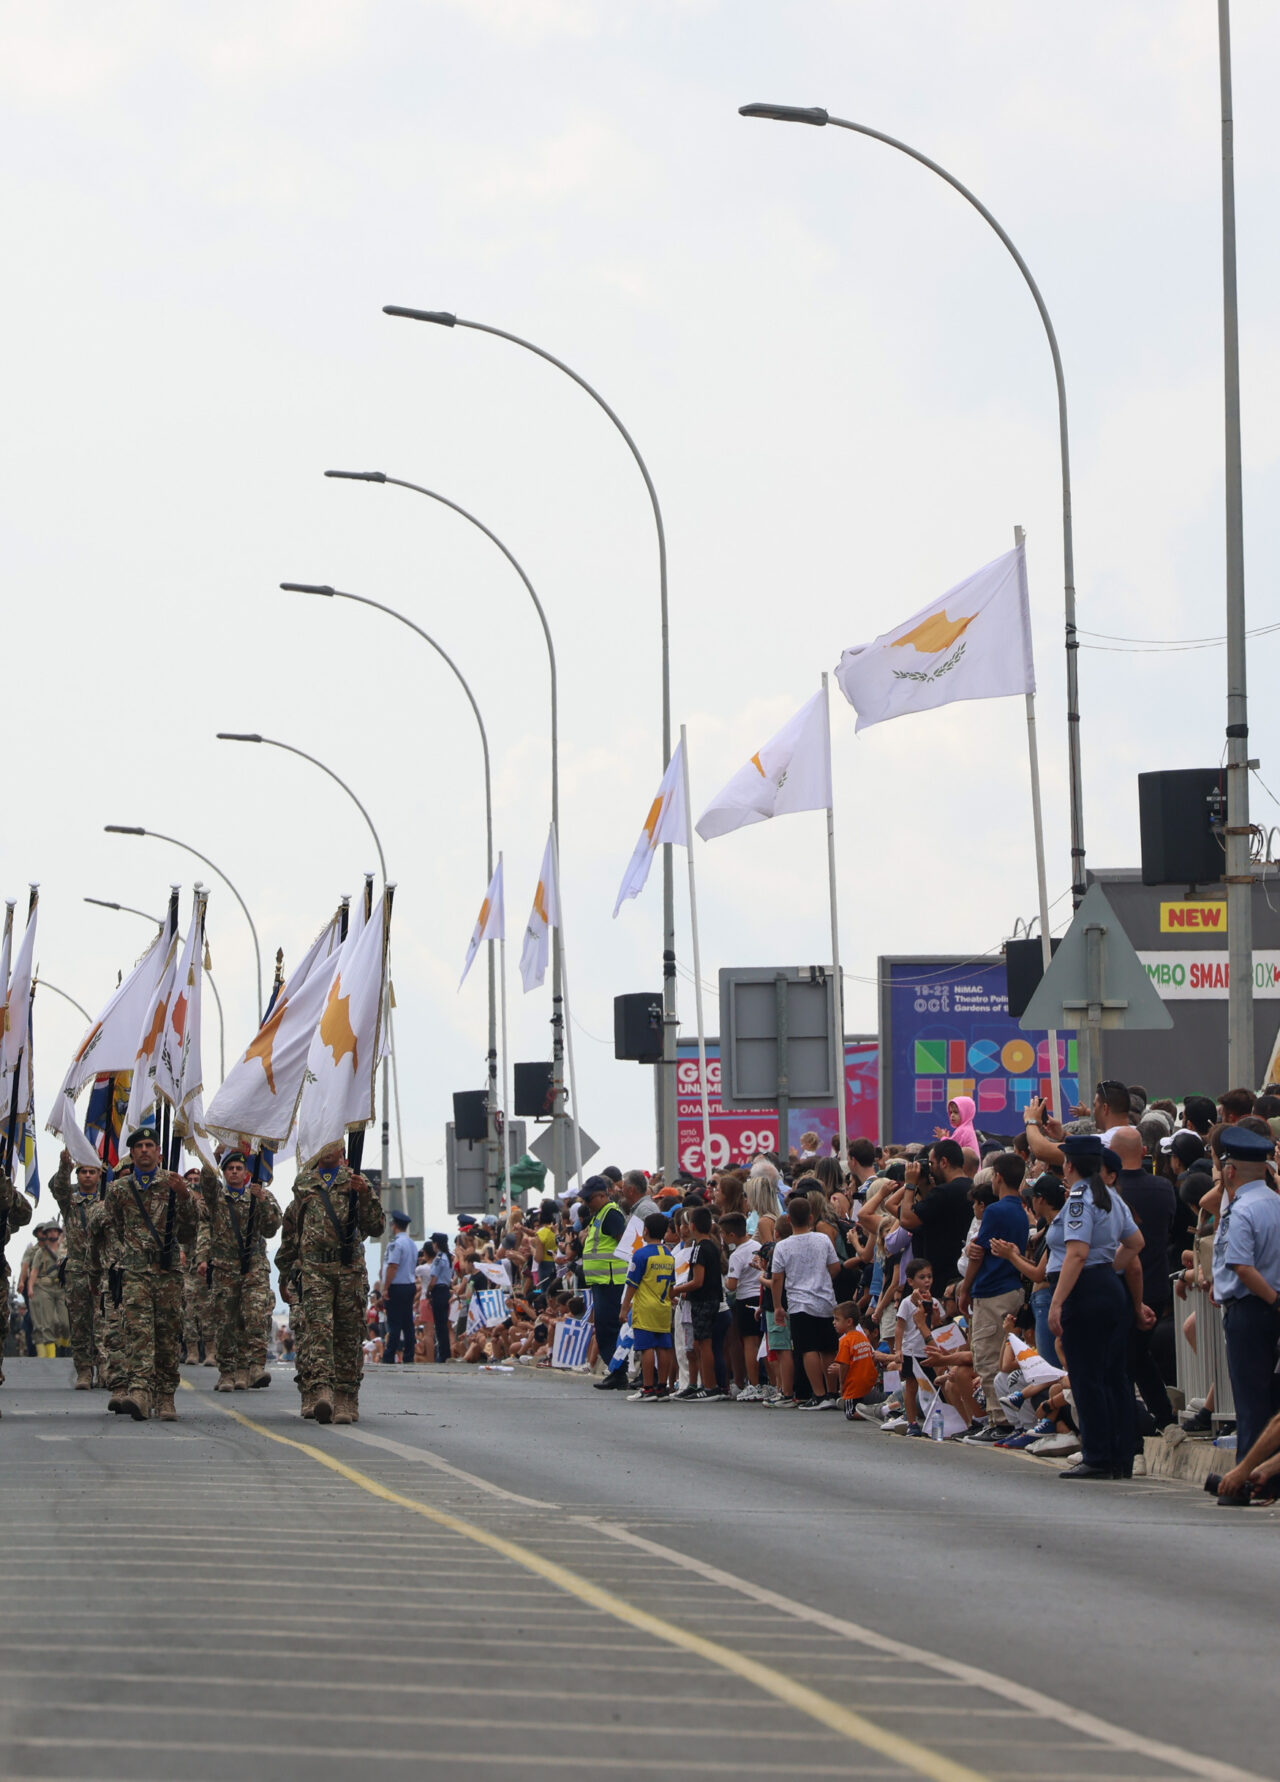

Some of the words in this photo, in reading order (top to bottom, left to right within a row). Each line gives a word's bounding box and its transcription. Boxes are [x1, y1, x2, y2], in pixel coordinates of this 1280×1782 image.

[1168, 908, 1221, 927] NEW
[1252, 963, 1274, 988] OX
[914, 986, 950, 996] 19-22
[914, 995, 951, 1012] oct
[955, 995, 988, 1004] Theatro
[954, 1004, 991, 1012] Gardens
[992, 1003, 1002, 1012] of
[678, 1084, 721, 1094] UNLMI
[656, 1275, 672, 1304] 7
